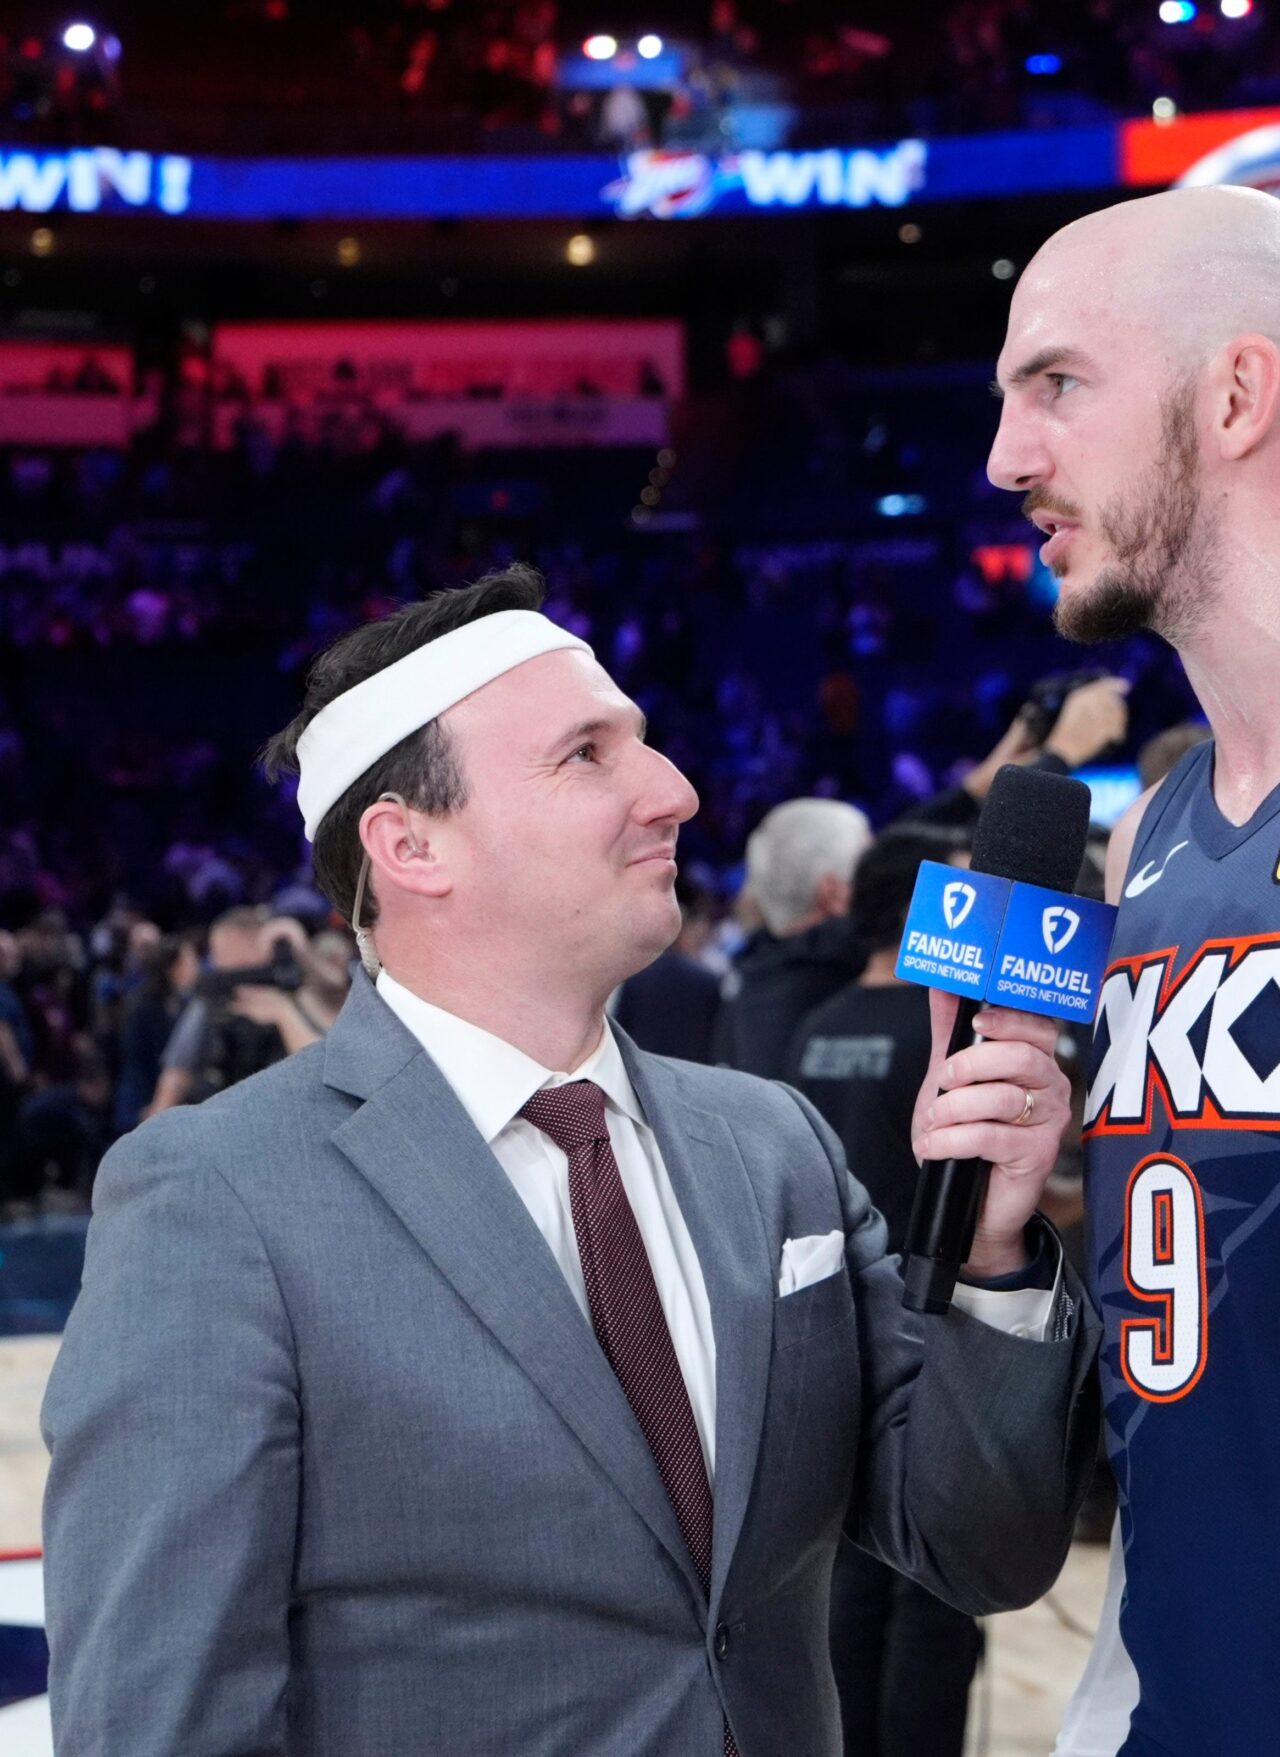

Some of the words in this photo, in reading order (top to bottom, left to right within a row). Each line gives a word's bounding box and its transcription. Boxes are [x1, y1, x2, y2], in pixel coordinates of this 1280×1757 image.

[0, 148, 191, 214] WIN!
[907, 931, 984, 969] FANDUEL
[903, 955, 937, 974] SPORTS
[937, 964, 981, 985] NETWORK
[1000, 954, 1092, 994] FANDUEL
[997, 980, 1038, 999] SPORTS
[1038, 989, 1088, 1010] NETWORK
[1123, 1156, 1204, 1399] 9
